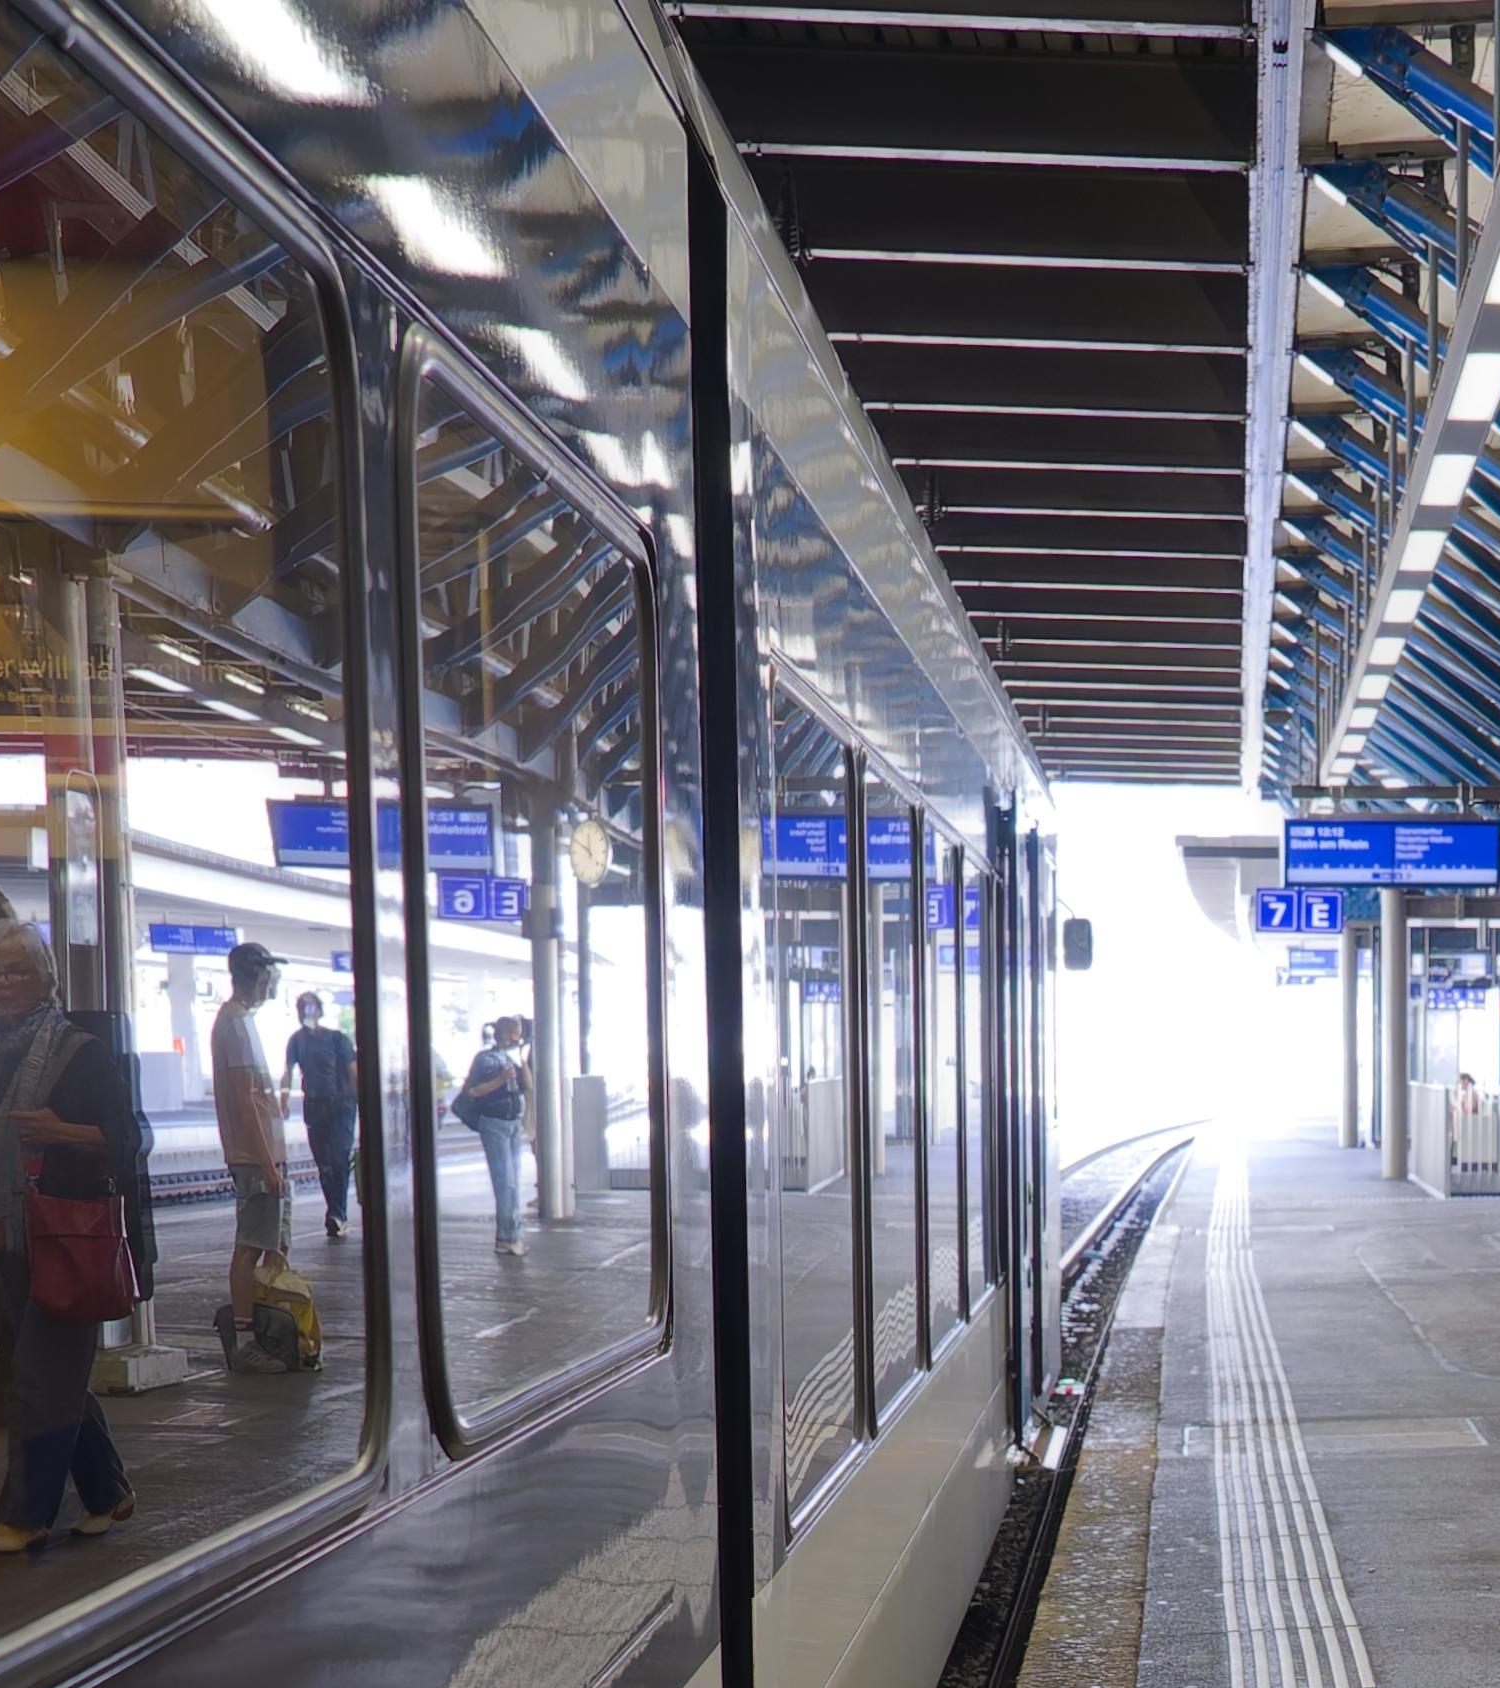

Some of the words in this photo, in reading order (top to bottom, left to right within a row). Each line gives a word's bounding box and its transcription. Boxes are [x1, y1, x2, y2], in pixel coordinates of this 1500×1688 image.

[1319, 839, 1337, 850] am
[1268, 902, 1287, 926] 7
[1311, 903, 1330, 928] E
